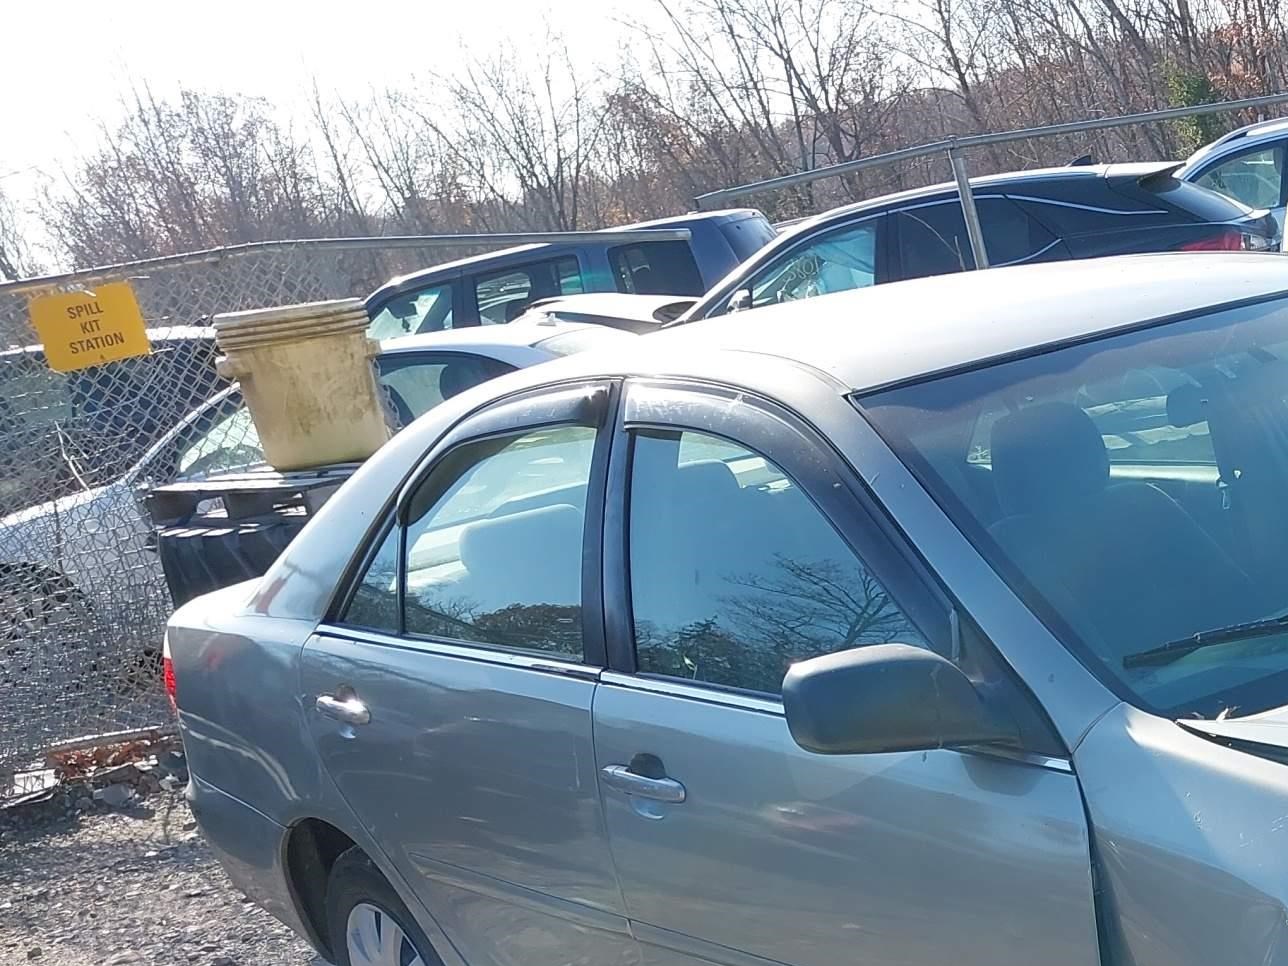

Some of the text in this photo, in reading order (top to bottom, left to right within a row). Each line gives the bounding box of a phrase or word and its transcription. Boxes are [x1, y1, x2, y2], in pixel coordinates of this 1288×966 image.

[66, 301, 104, 320] SPILL
[79, 319, 101, 334] KIT
[69, 331, 125, 355] STATION
